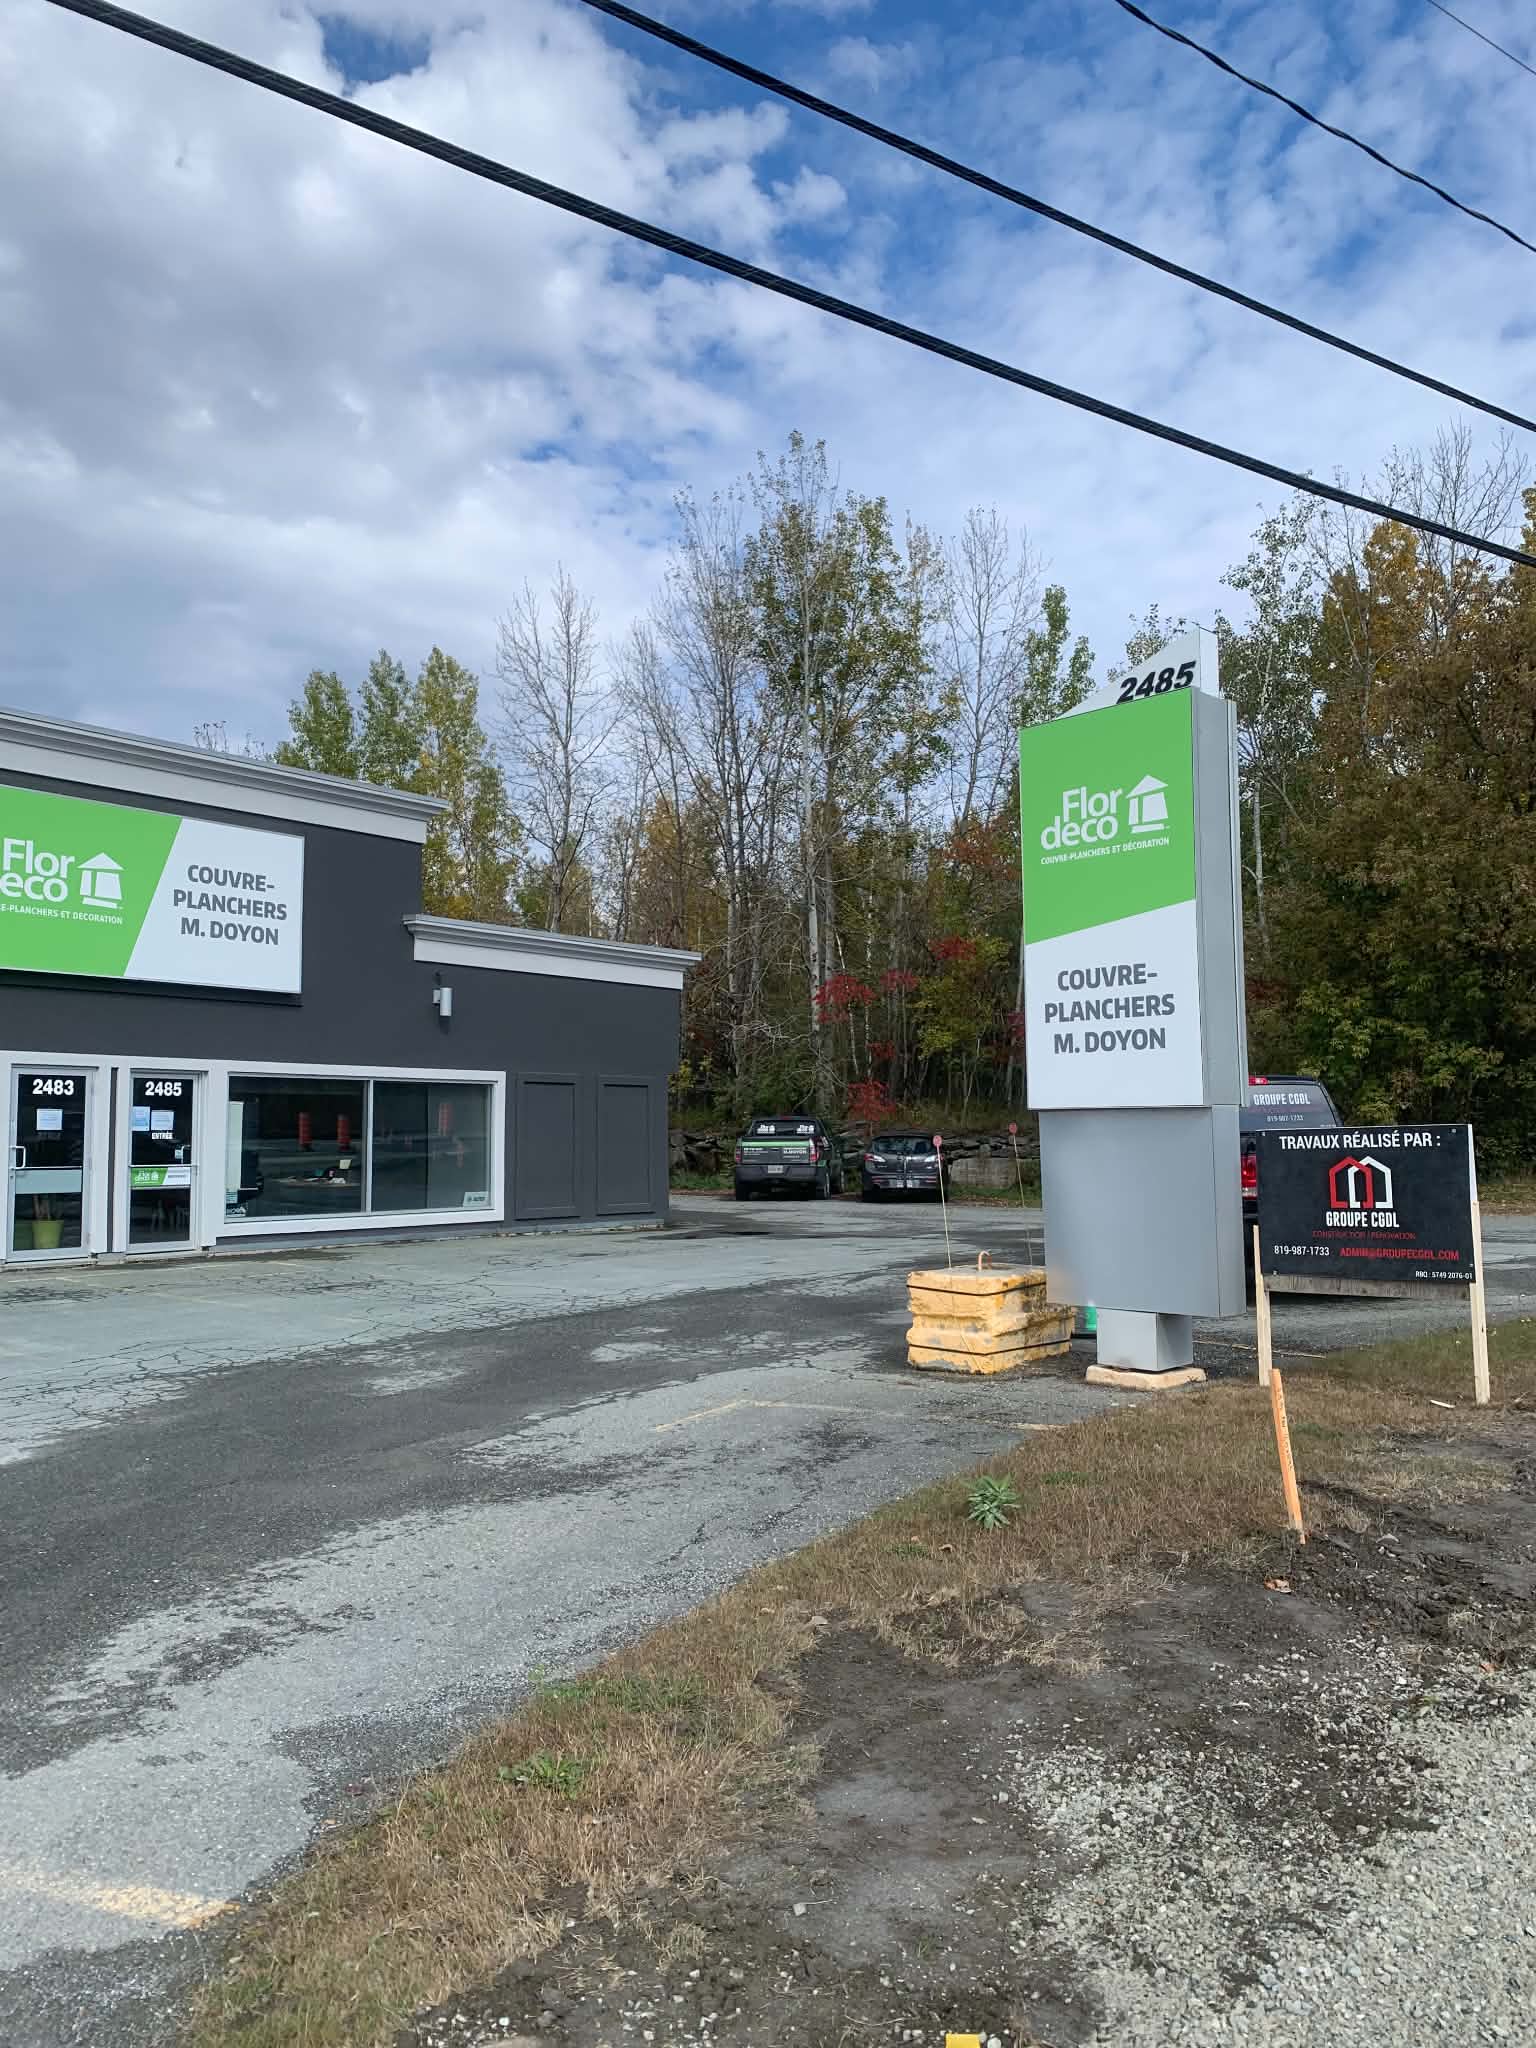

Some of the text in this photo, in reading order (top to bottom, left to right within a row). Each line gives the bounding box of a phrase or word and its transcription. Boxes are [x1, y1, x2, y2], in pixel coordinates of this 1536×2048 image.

[1117, 661, 1196, 705] 2485
[1063, 786, 1122, 822] Flor
[1041, 815, 1119, 850] deco
[3, 837, 75, 879] Flor
[0, 871, 69, 903] eco
[187, 864, 275, 892] COUVRE-
[0, 903, 59, 918] E-PLANCHERS
[173, 889, 287, 921] PLANCHERS
[181, 917, 279, 946] M. DOYON
[1057, 963, 1158, 991] COUVRE-
[1044, 993, 1176, 1024] PLANCHERS
[1054, 1027, 1167, 1054] M. DOYON
[32, 1078, 75, 1096] 2483
[145, 1081, 183, 1097] 2485
[1279, 1135, 1341, 1149] TRAVAUX
[1343, 1130, 1400, 1149] RÉALISÉ
[1403, 1133, 1432, 1148] PAR
[1326, 1211, 1400, 1228] GROUPE CGDL
[1274, 1245, 1330, 1256] 819-987-1733
